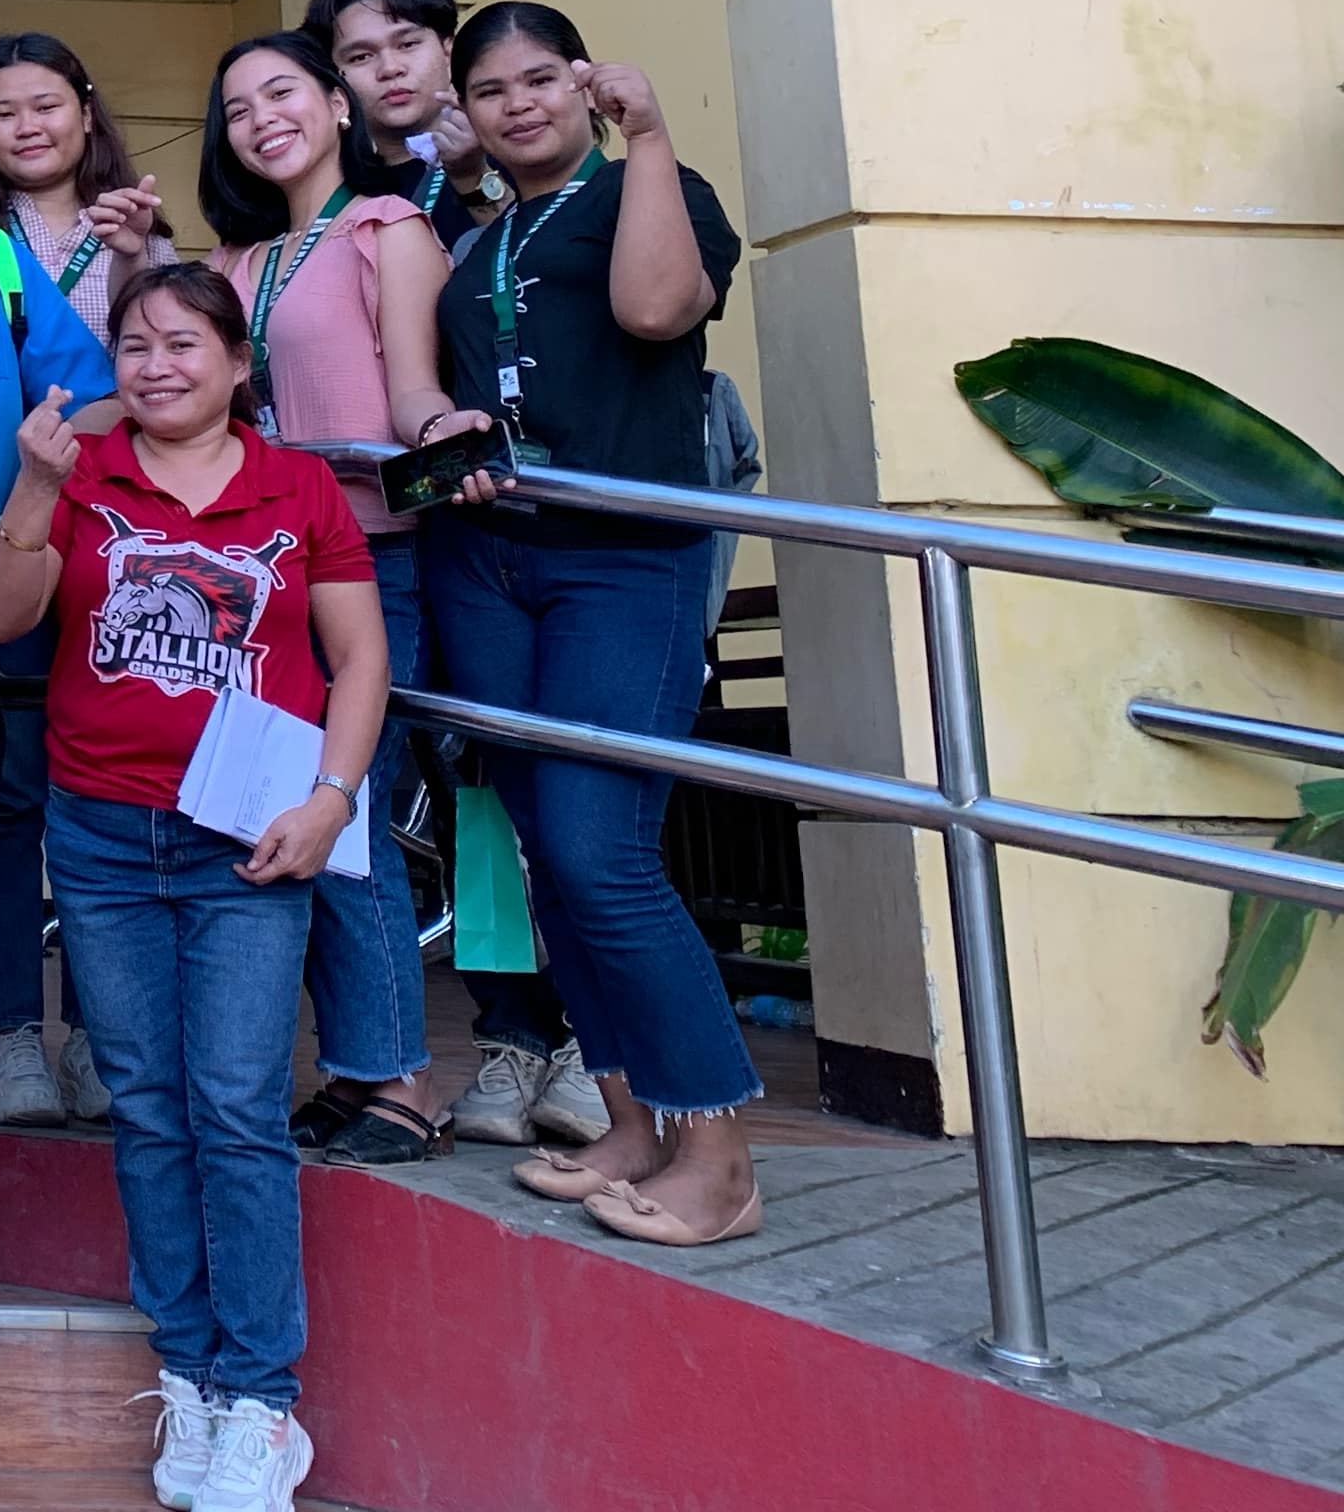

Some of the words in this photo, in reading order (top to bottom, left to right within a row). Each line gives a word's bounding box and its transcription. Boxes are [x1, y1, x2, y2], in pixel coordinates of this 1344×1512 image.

[96, 626, 255, 696] STALLION
[128, 660, 195, 685] GRADE
[195, 671, 216, 688] 12
